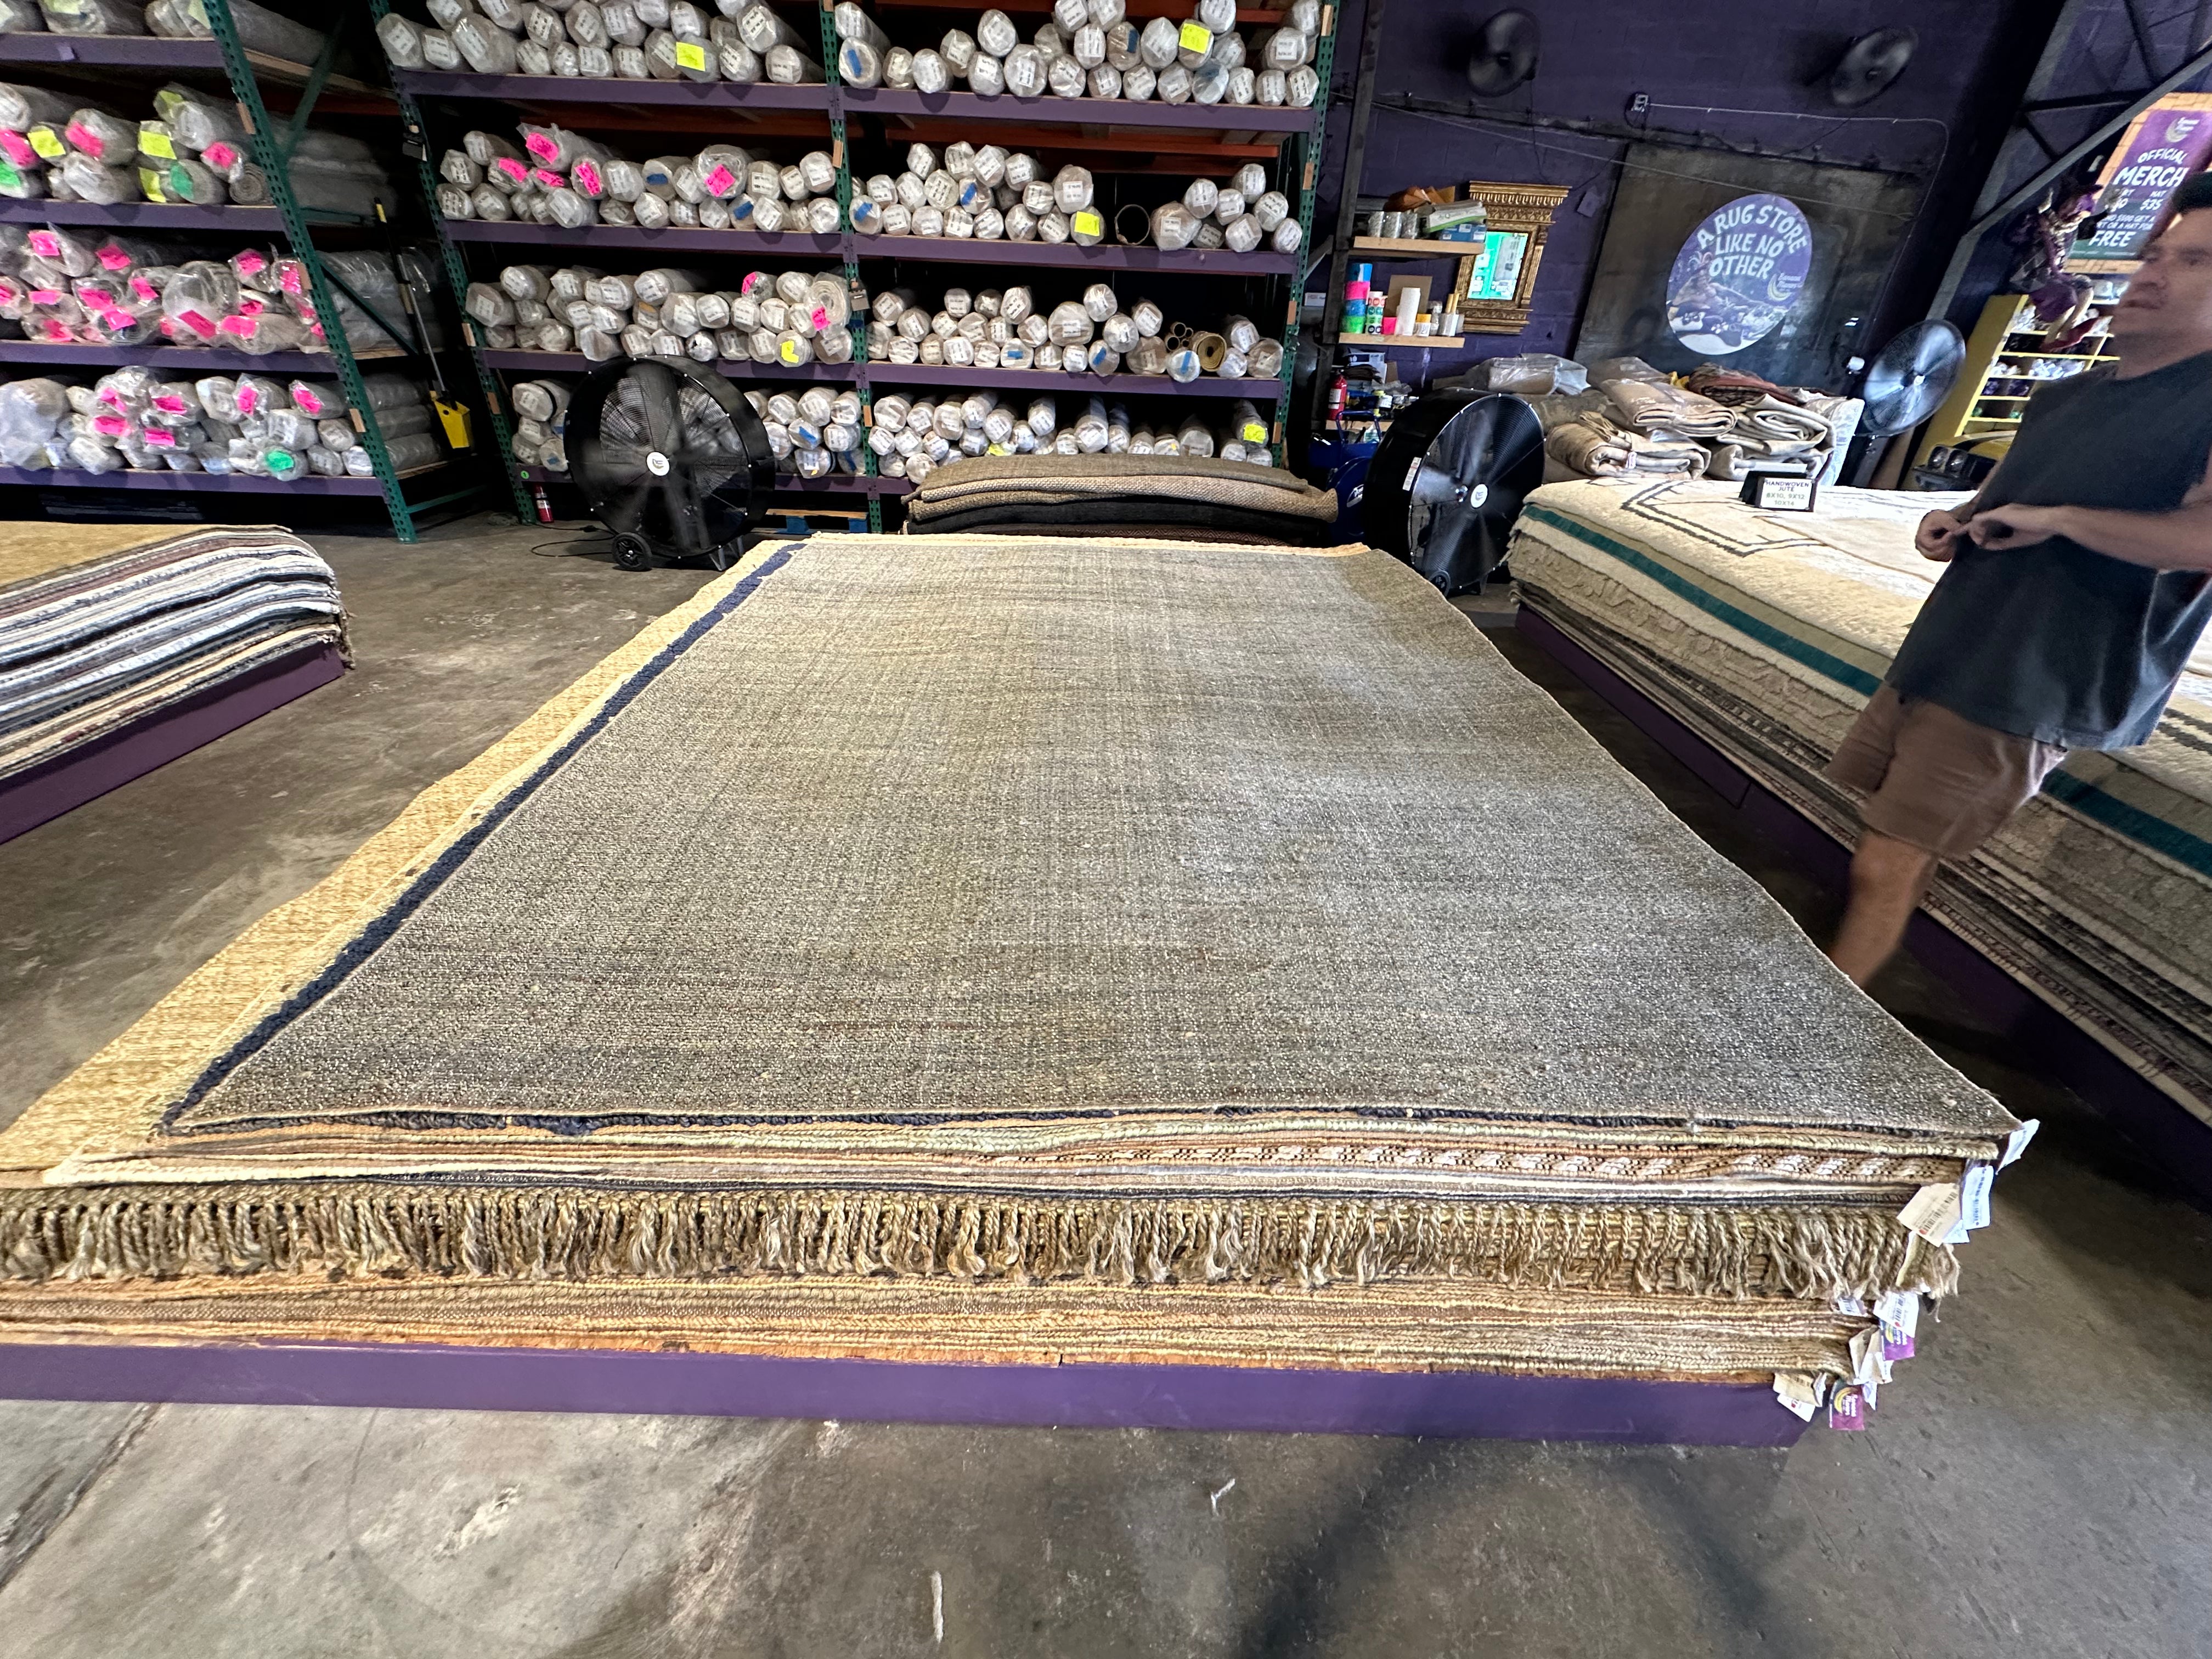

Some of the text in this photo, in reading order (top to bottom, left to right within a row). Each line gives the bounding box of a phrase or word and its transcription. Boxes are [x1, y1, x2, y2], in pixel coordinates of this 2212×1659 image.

[2137, 148, 2188, 164] OFFICIAL
[2112, 166, 2190, 187] MERCH
[2140, 198, 2164, 211] $35
[1697, 204, 1808, 254] A RUG STORE
[2089, 230, 2137, 247] FREE
[1716, 233, 1785, 258] LIKE NO
[1709, 255, 1775, 280] OTHER
